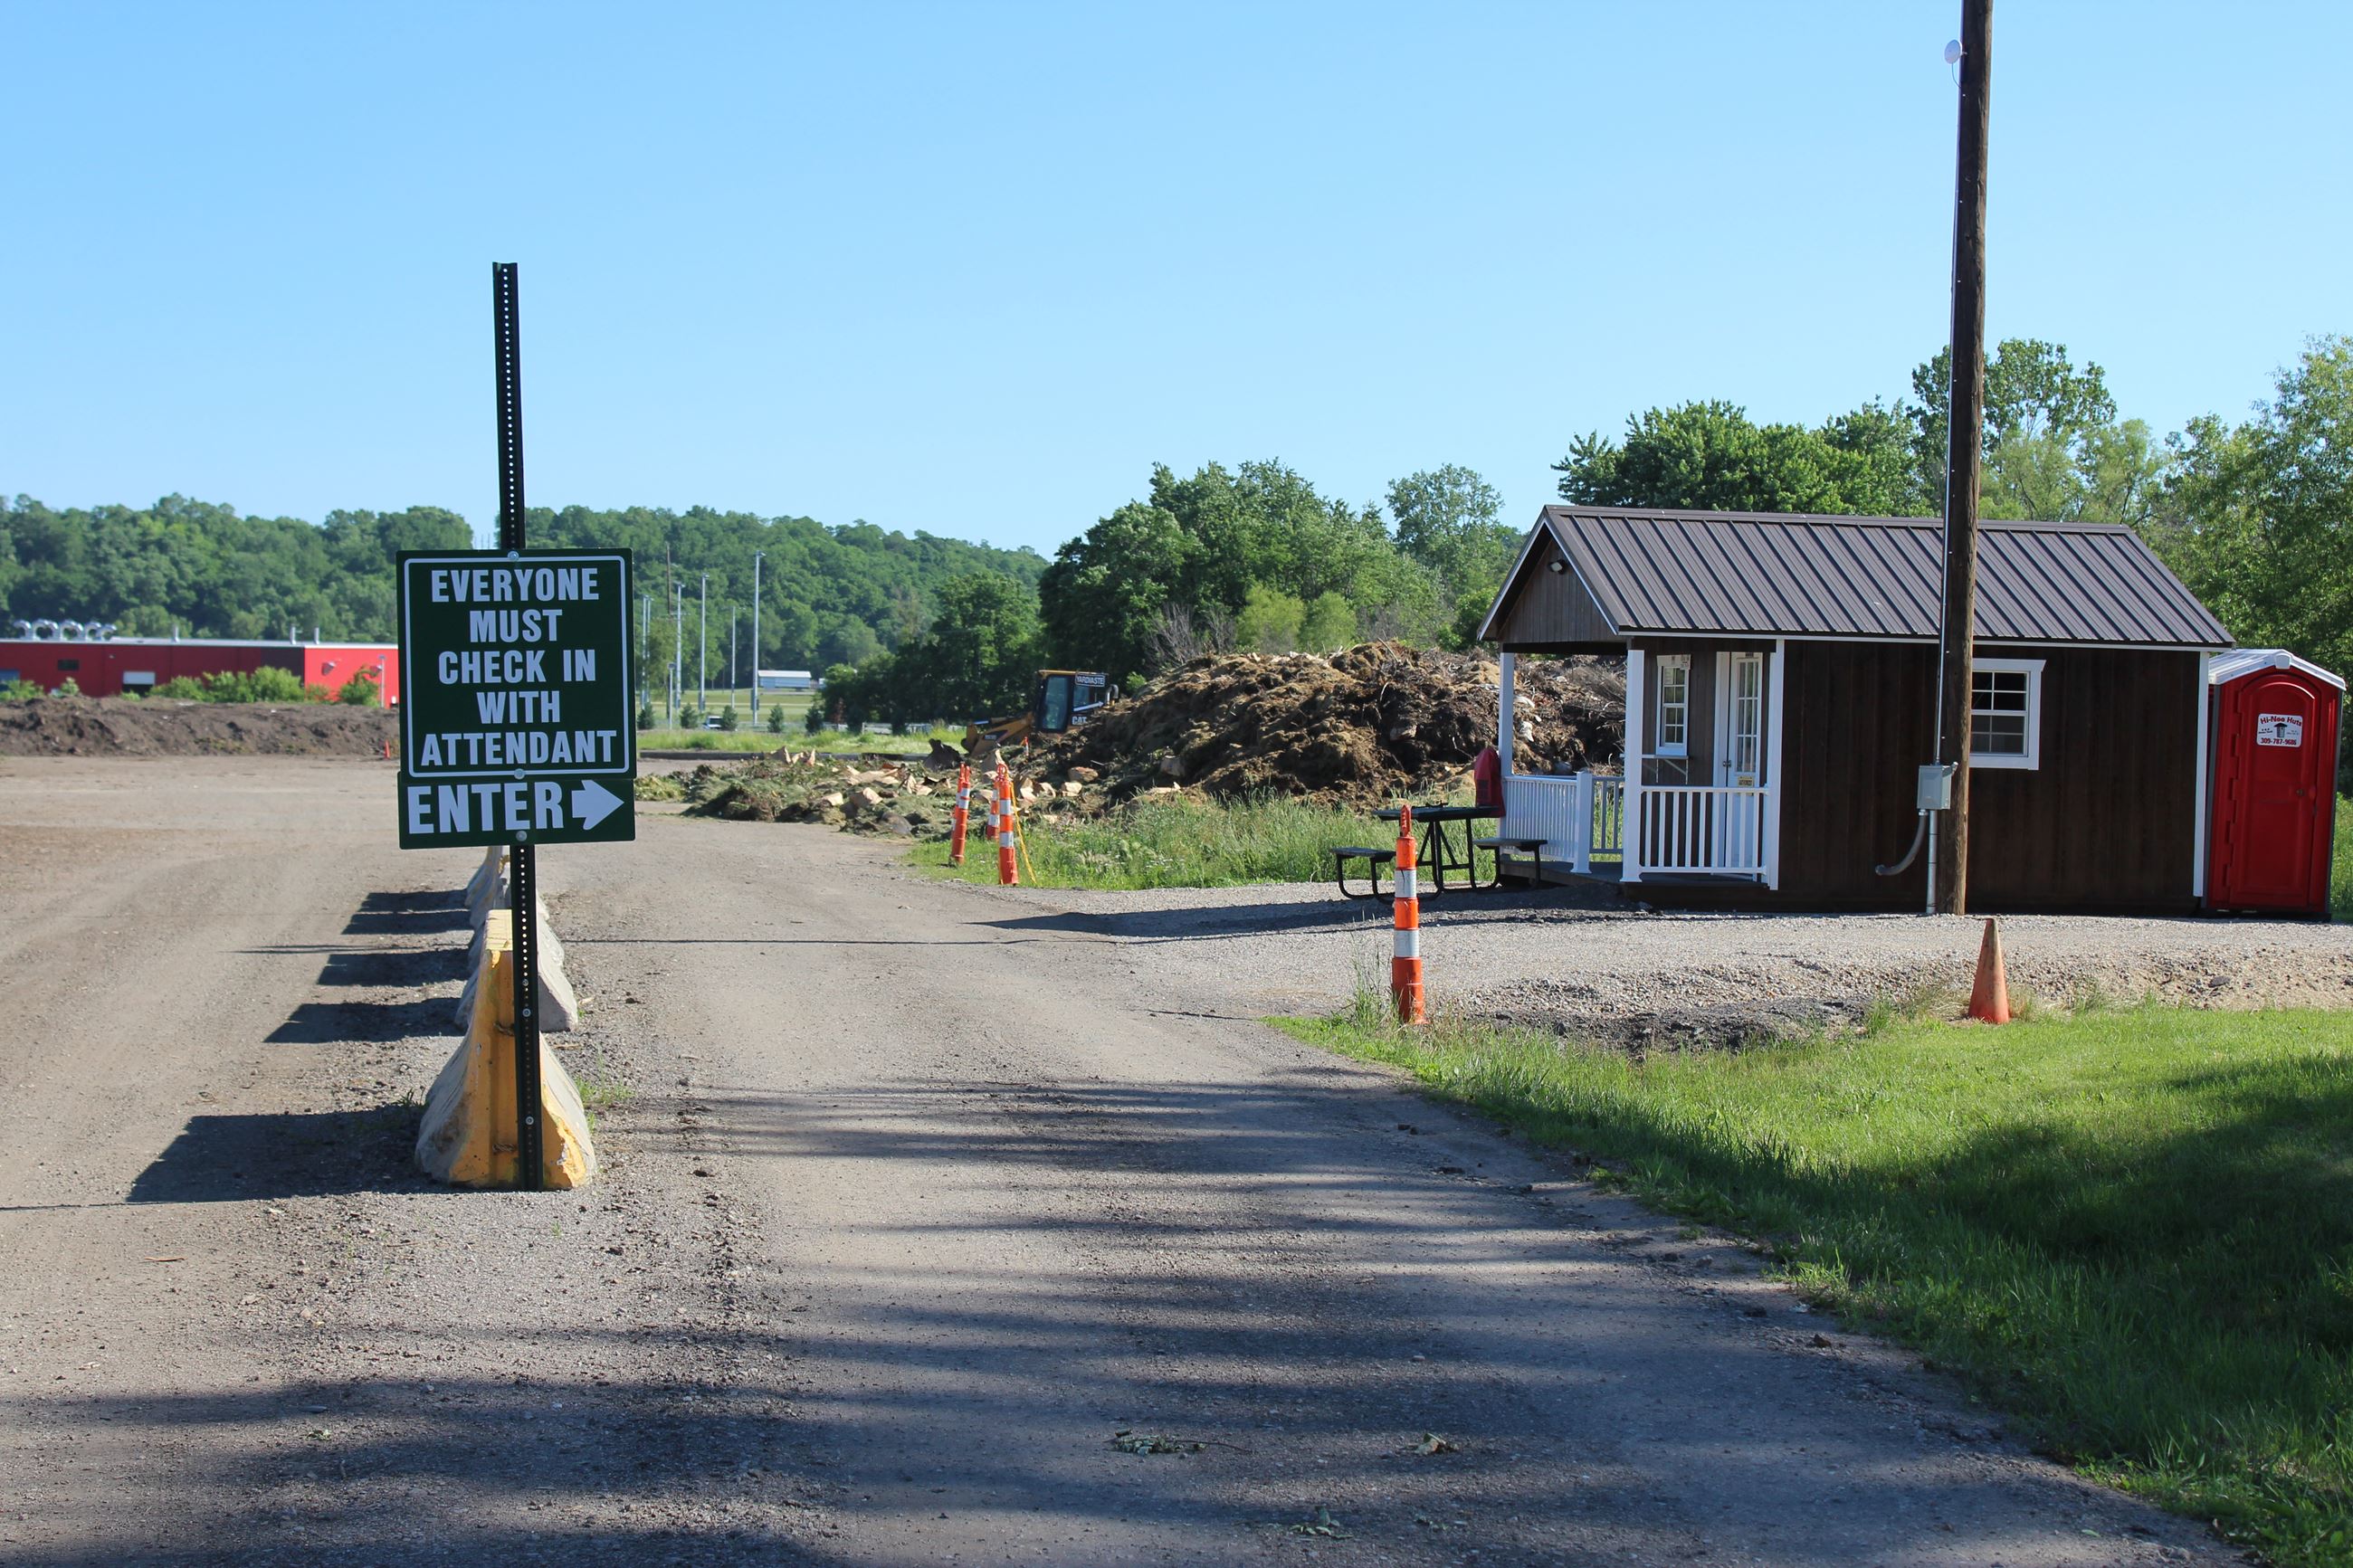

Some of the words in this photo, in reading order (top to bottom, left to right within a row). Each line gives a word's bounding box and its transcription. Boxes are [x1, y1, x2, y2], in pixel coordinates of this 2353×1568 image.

[431, 568, 599, 603] EVERYONE
[469, 609, 562, 642] MUST
[438, 650, 547, 684] CHECK
[563, 650, 595, 681] IN
[476, 690, 560, 724] WITH
[1072, 716, 1087, 725] CAT
[2287, 717, 2301, 726] Huts
[421, 730, 617, 765] ATTENDANT
[407, 781, 564, 834] ENTER
